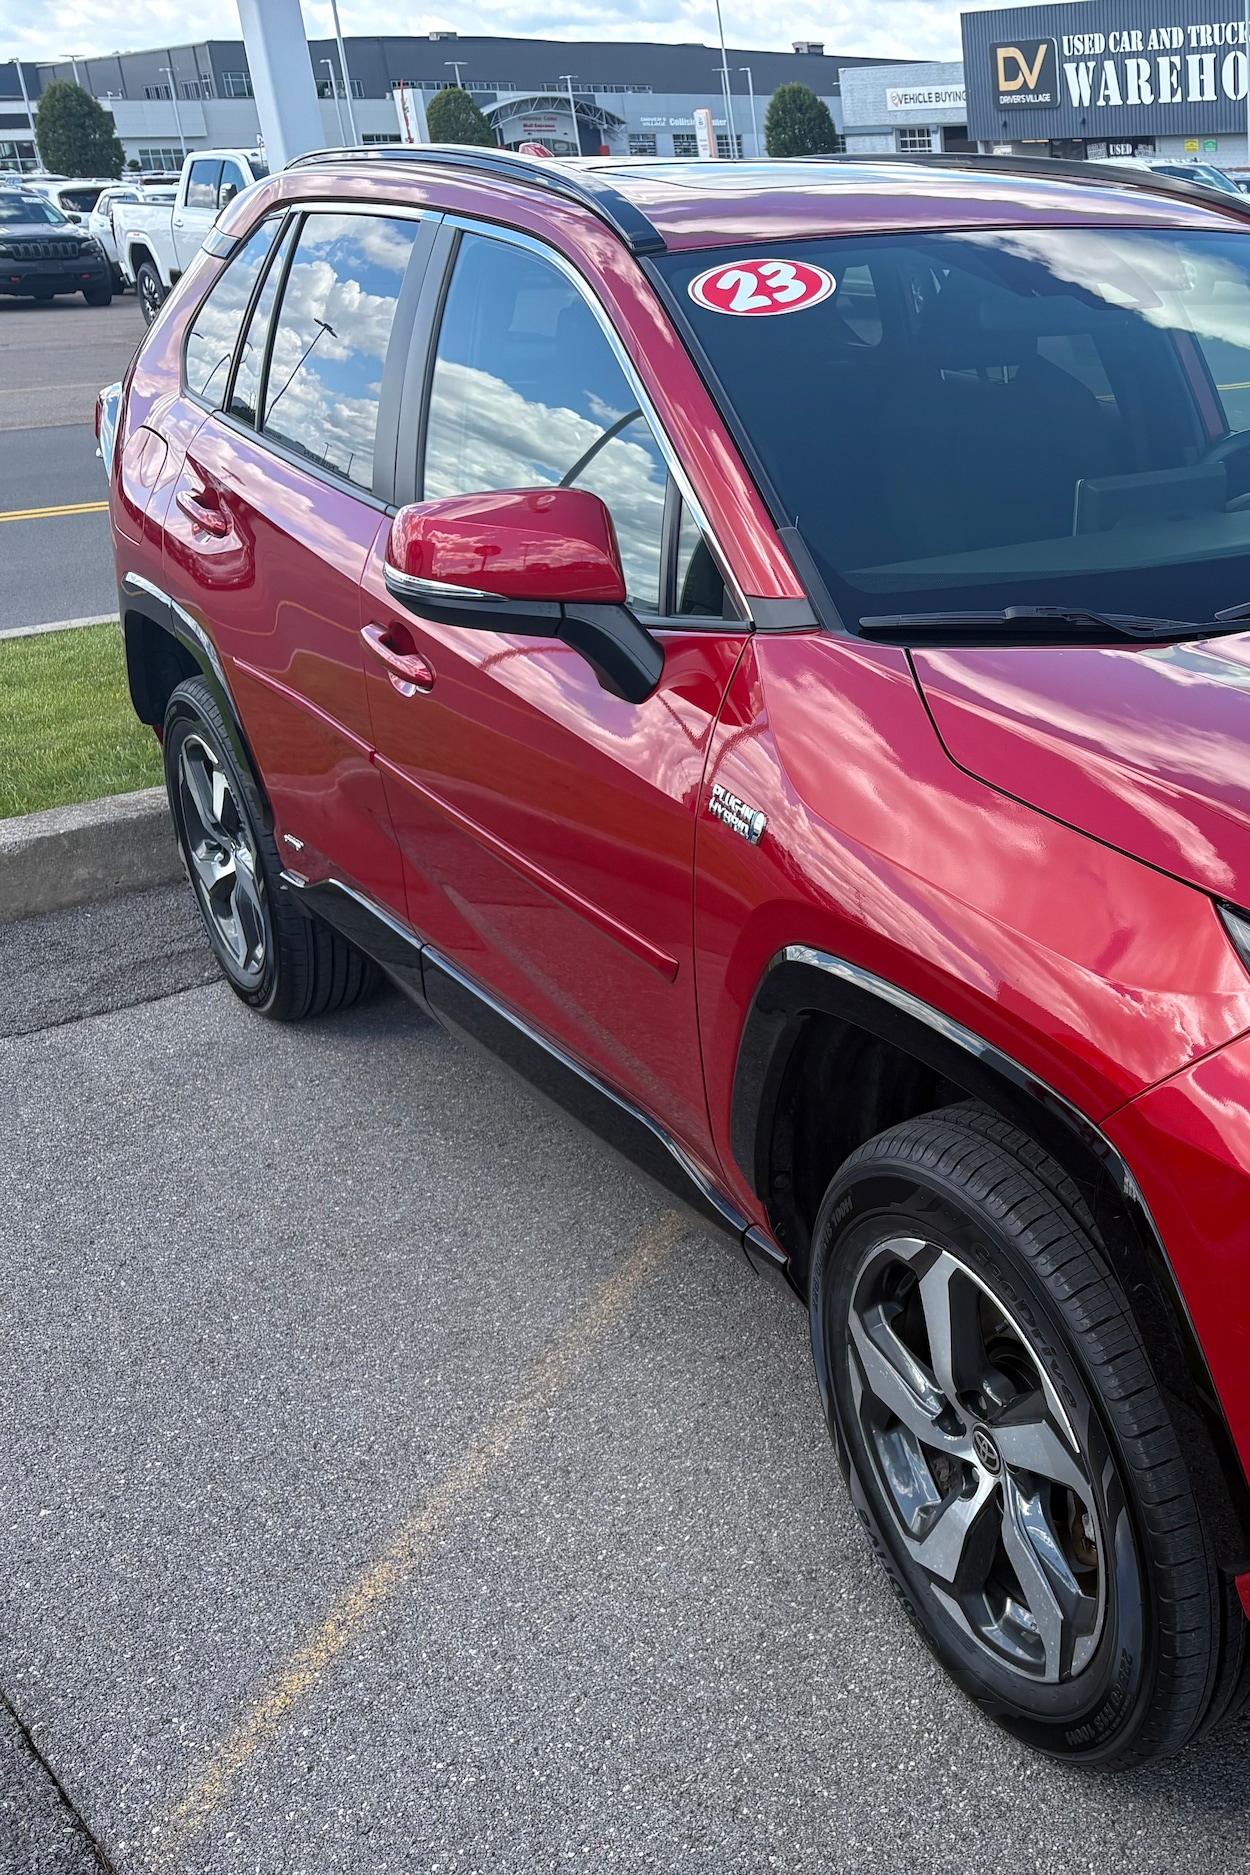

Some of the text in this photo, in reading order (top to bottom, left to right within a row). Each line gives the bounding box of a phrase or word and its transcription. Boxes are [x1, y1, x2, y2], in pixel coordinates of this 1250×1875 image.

[1062, 33, 1106, 56] USED
[1108, 30, 1144, 53] CAR
[1147, 26, 1184, 50] AND
[997, 44, 1047, 91] DV
[898, 90, 967, 104] VEHICLE BUYING
[1026, 93, 1051, 103] VILLAGE
[669, 117, 695, 126] Collisi
[1110, 143, 1132, 155] USED
[716, 262, 807, 312] 23
